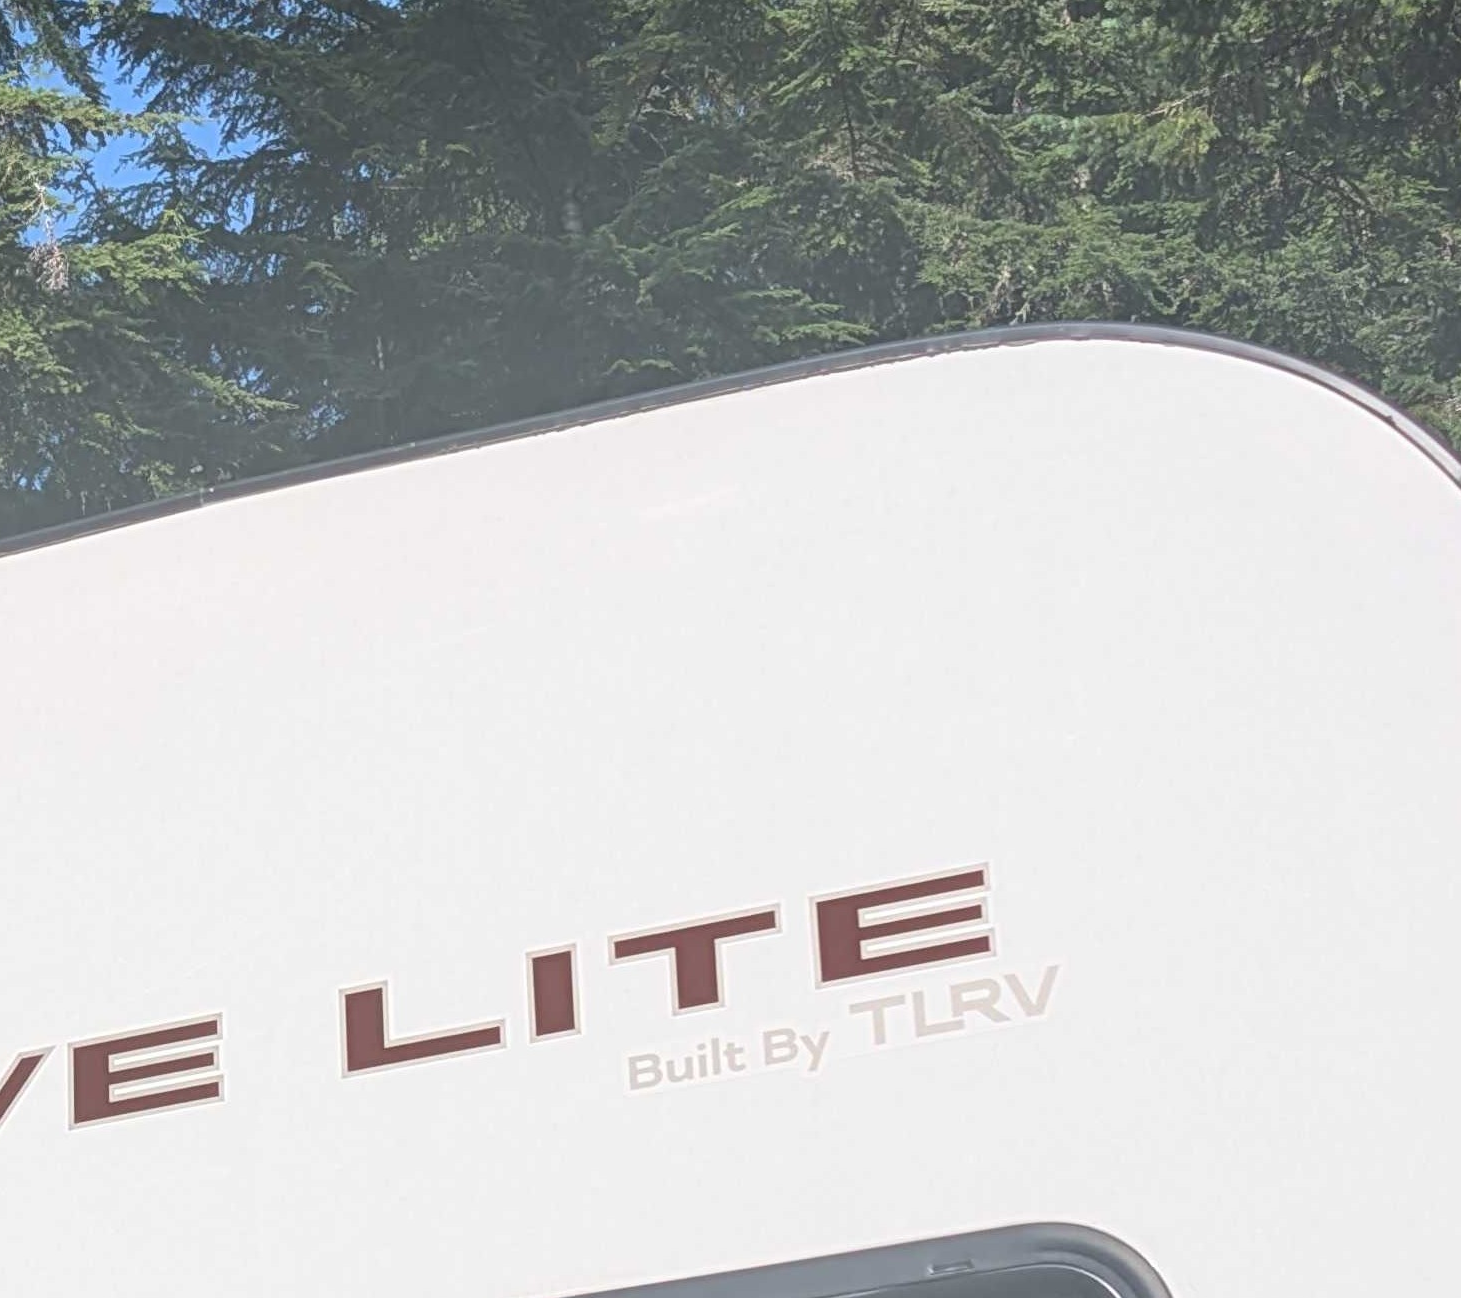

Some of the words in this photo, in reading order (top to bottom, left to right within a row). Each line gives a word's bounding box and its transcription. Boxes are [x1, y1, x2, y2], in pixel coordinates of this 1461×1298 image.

[339, 861, 993, 1075] LITE
[628, 1038, 751, 1092] Built
[762, 1021, 831, 1075] By
[848, 965, 1060, 1046] TLRV
